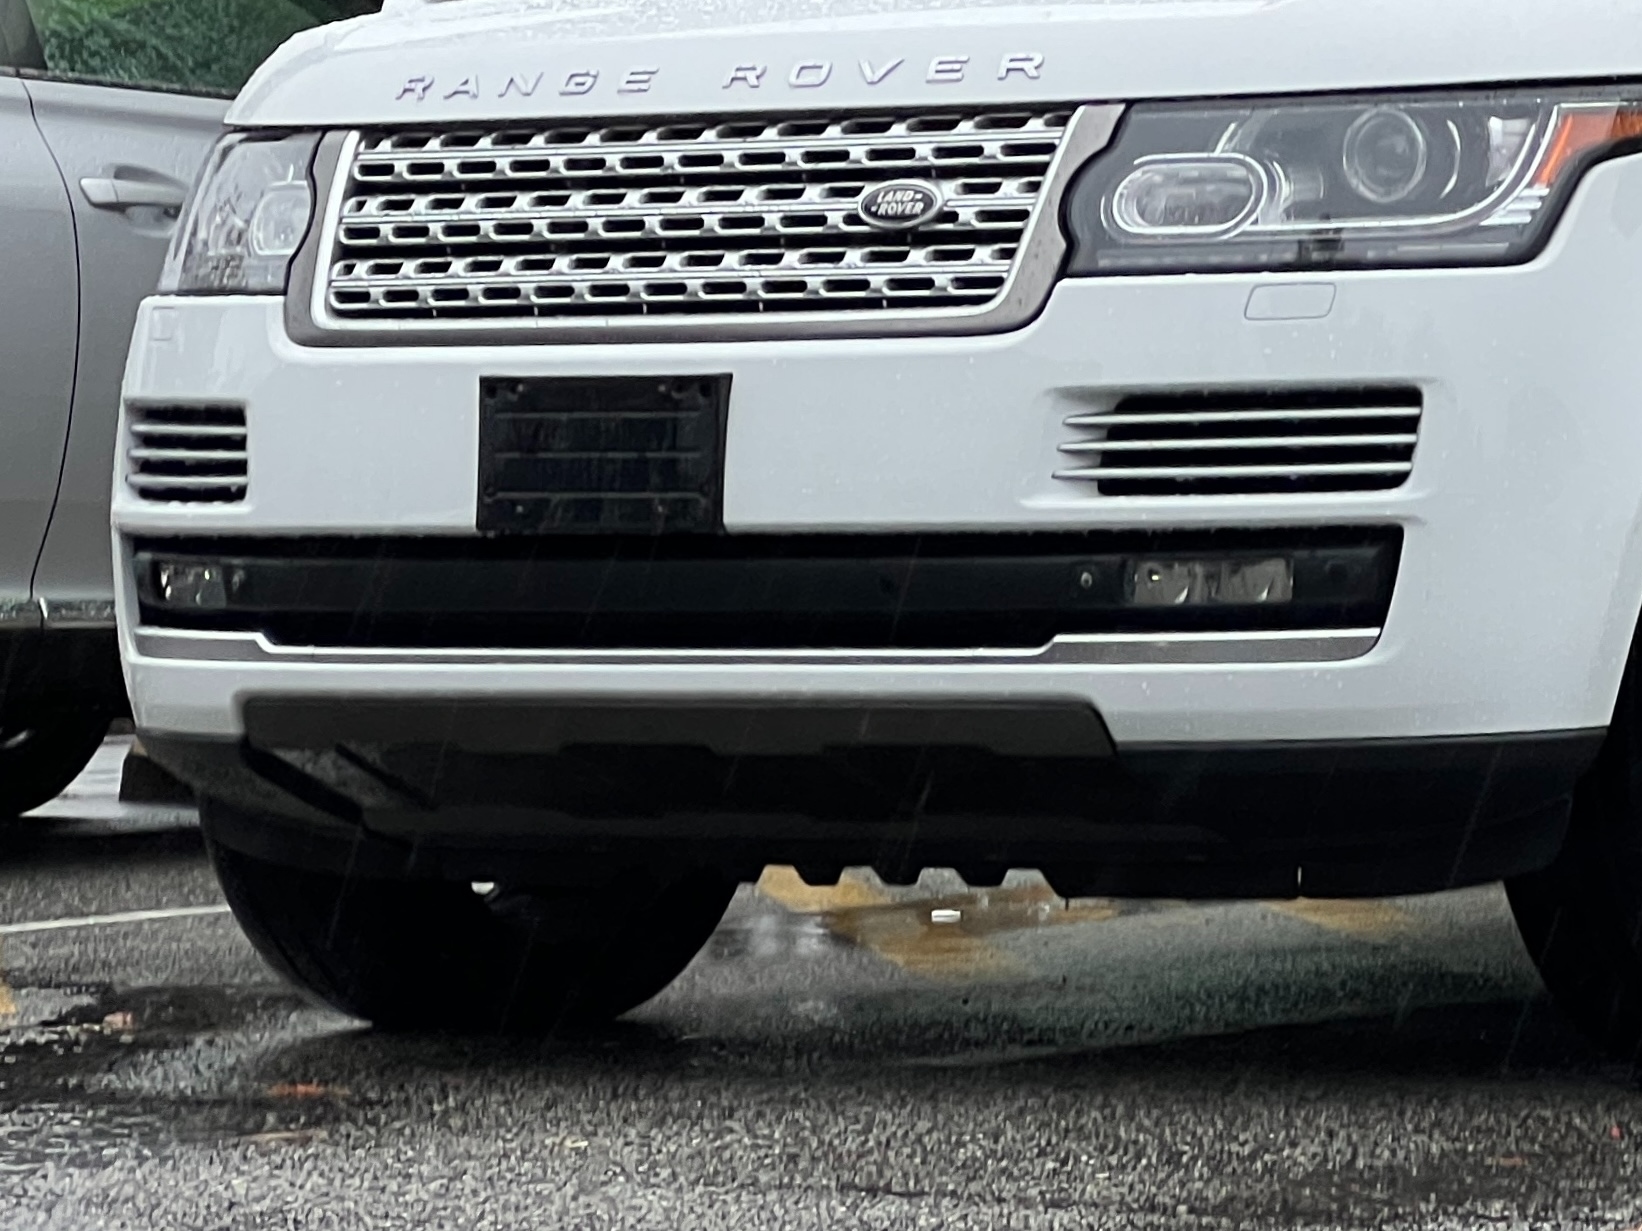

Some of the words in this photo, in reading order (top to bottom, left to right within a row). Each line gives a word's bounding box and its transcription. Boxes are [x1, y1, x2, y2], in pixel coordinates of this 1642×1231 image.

[395, 66, 661, 102] RANGE
[722, 52, 1046, 89] ROVER
[877, 201, 924, 215] ROVER
